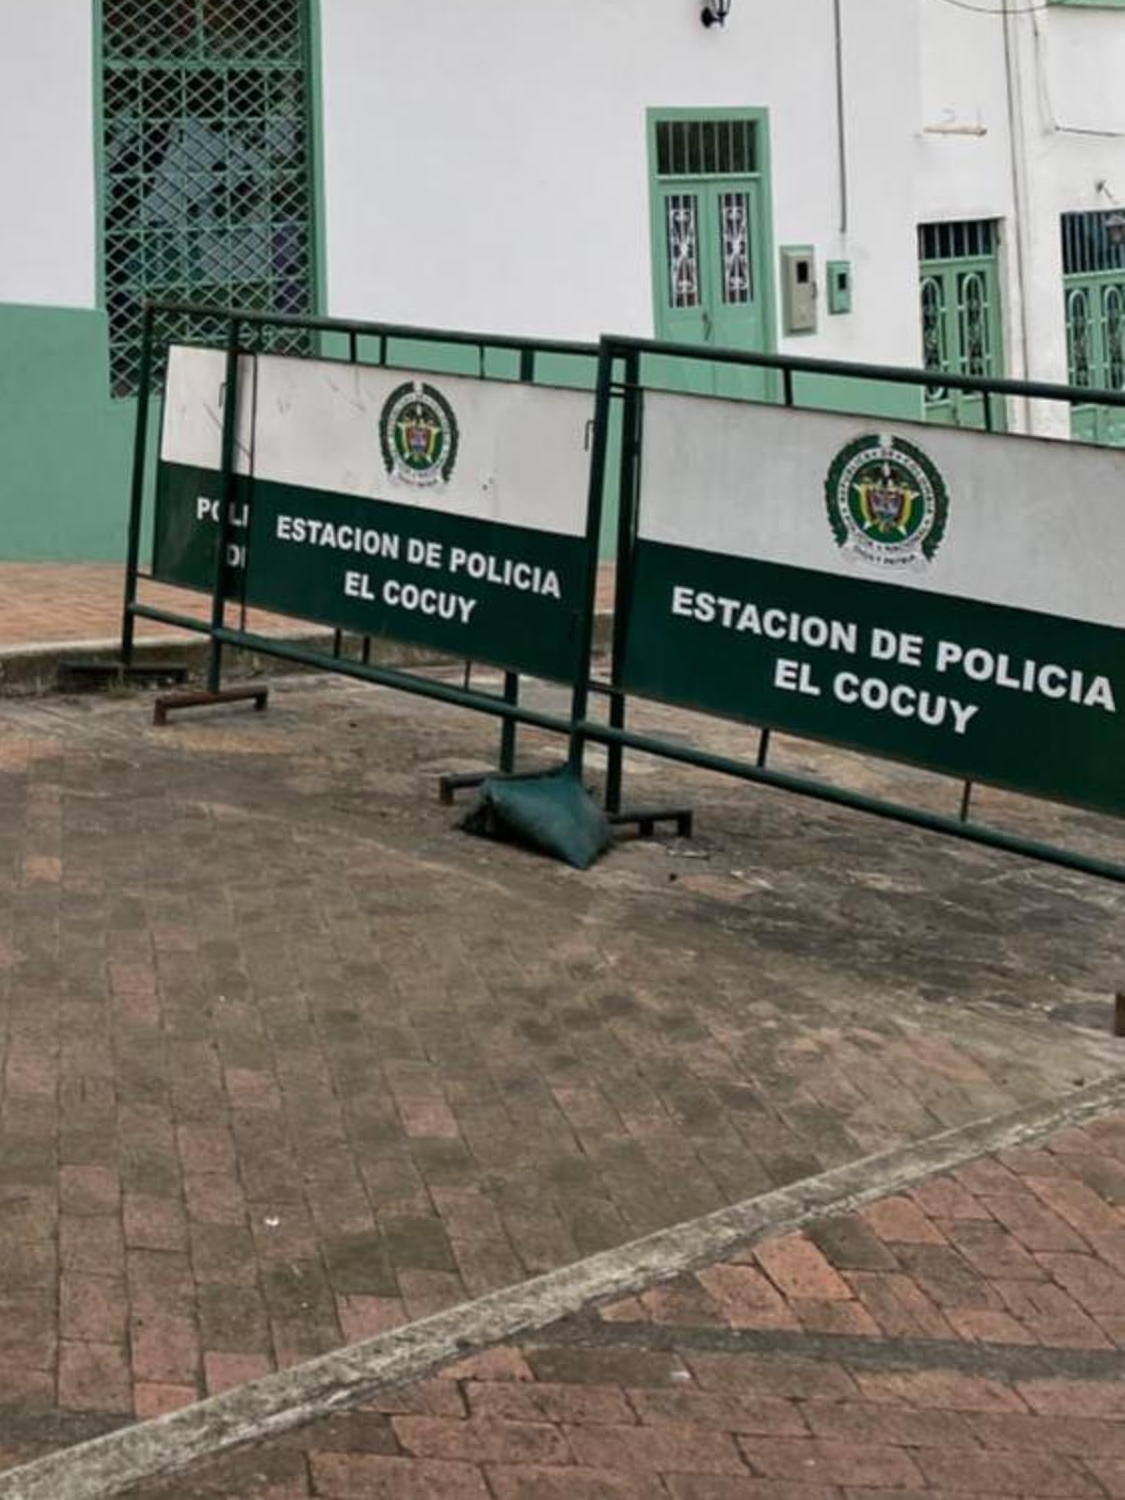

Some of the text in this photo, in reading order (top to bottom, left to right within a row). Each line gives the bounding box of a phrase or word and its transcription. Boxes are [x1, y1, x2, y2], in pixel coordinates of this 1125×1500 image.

[276, 515, 562, 599] ESTACION DE POLICIA
[344, 571, 477, 624] EL COCUY
[672, 586, 1116, 712] ESTACION DE POLICIA
[774, 658, 979, 735] EL COCUY
